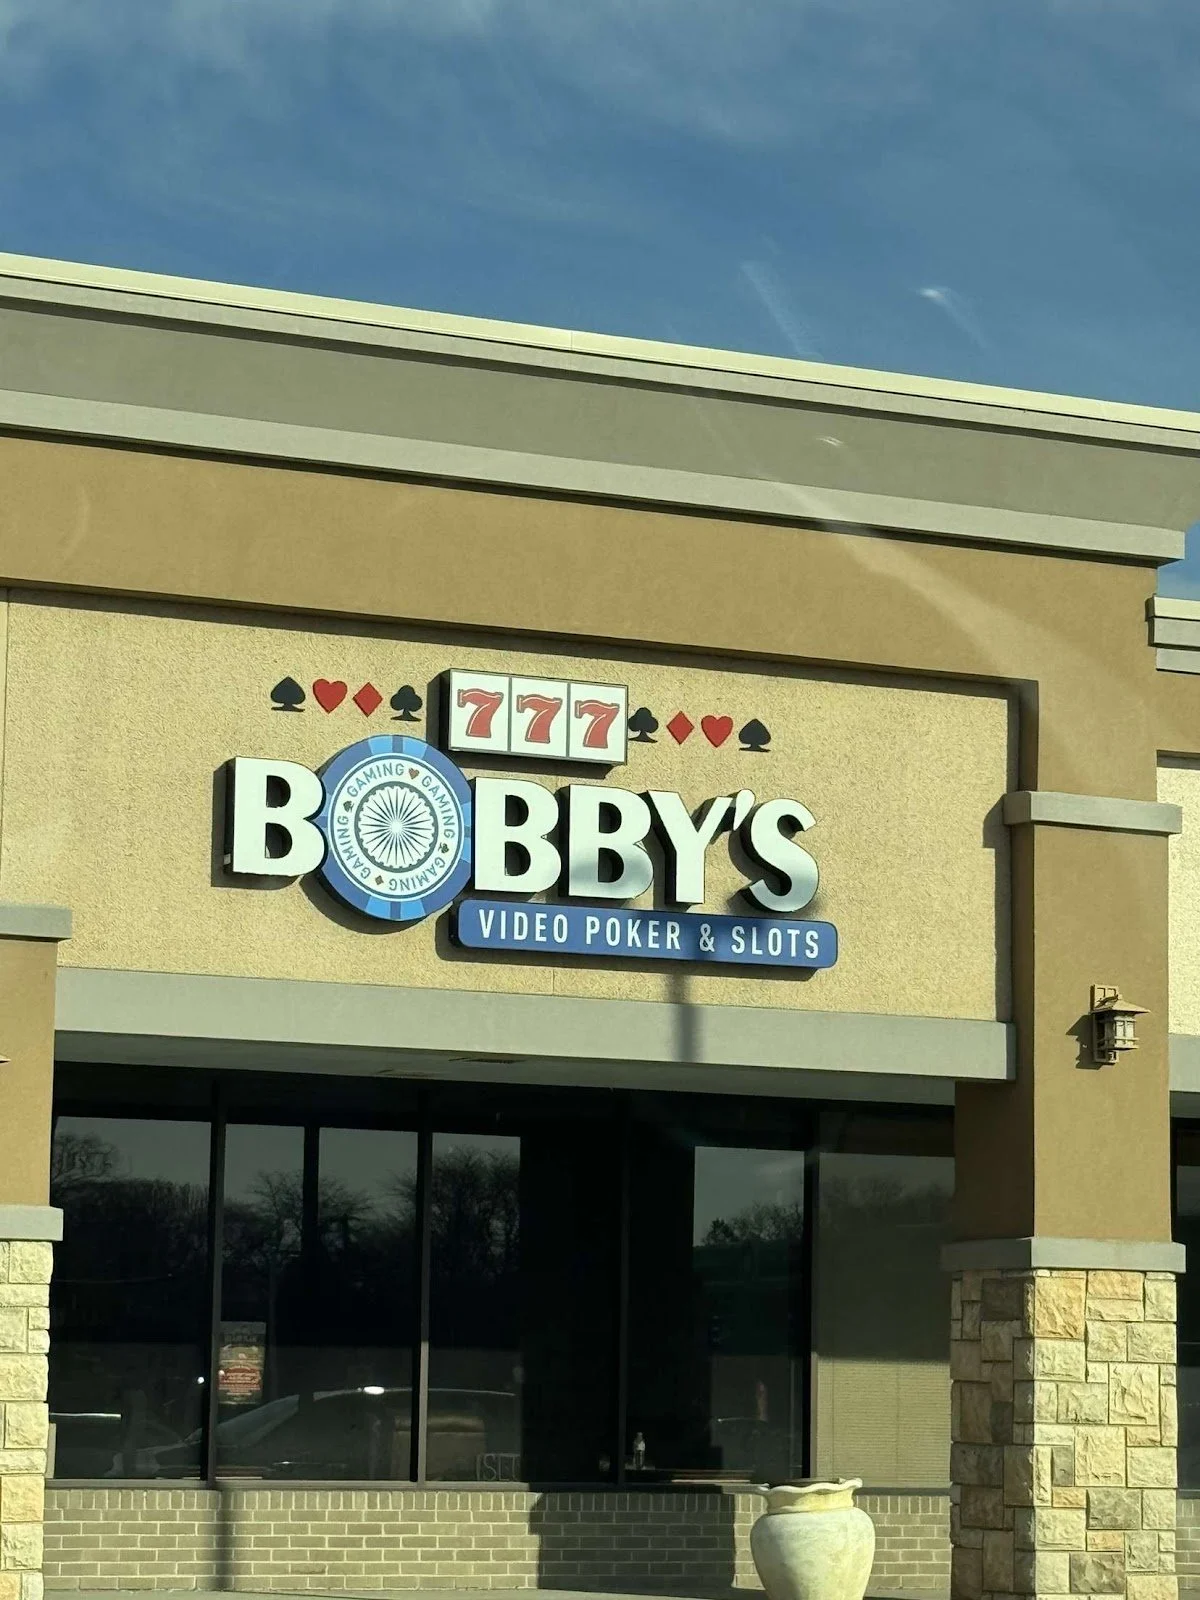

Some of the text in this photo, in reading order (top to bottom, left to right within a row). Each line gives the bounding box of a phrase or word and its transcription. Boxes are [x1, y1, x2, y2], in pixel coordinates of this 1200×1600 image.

[347, 762, 405, 797] GAMING
[421, 775, 456, 839] GAMING
[232, 734, 819, 922] BOBBY'S
[337, 816, 371, 879] GAMING
[388, 857, 446, 892] GAMING
[478, 908, 819, 959] VIDEO POKER & SLOTS
